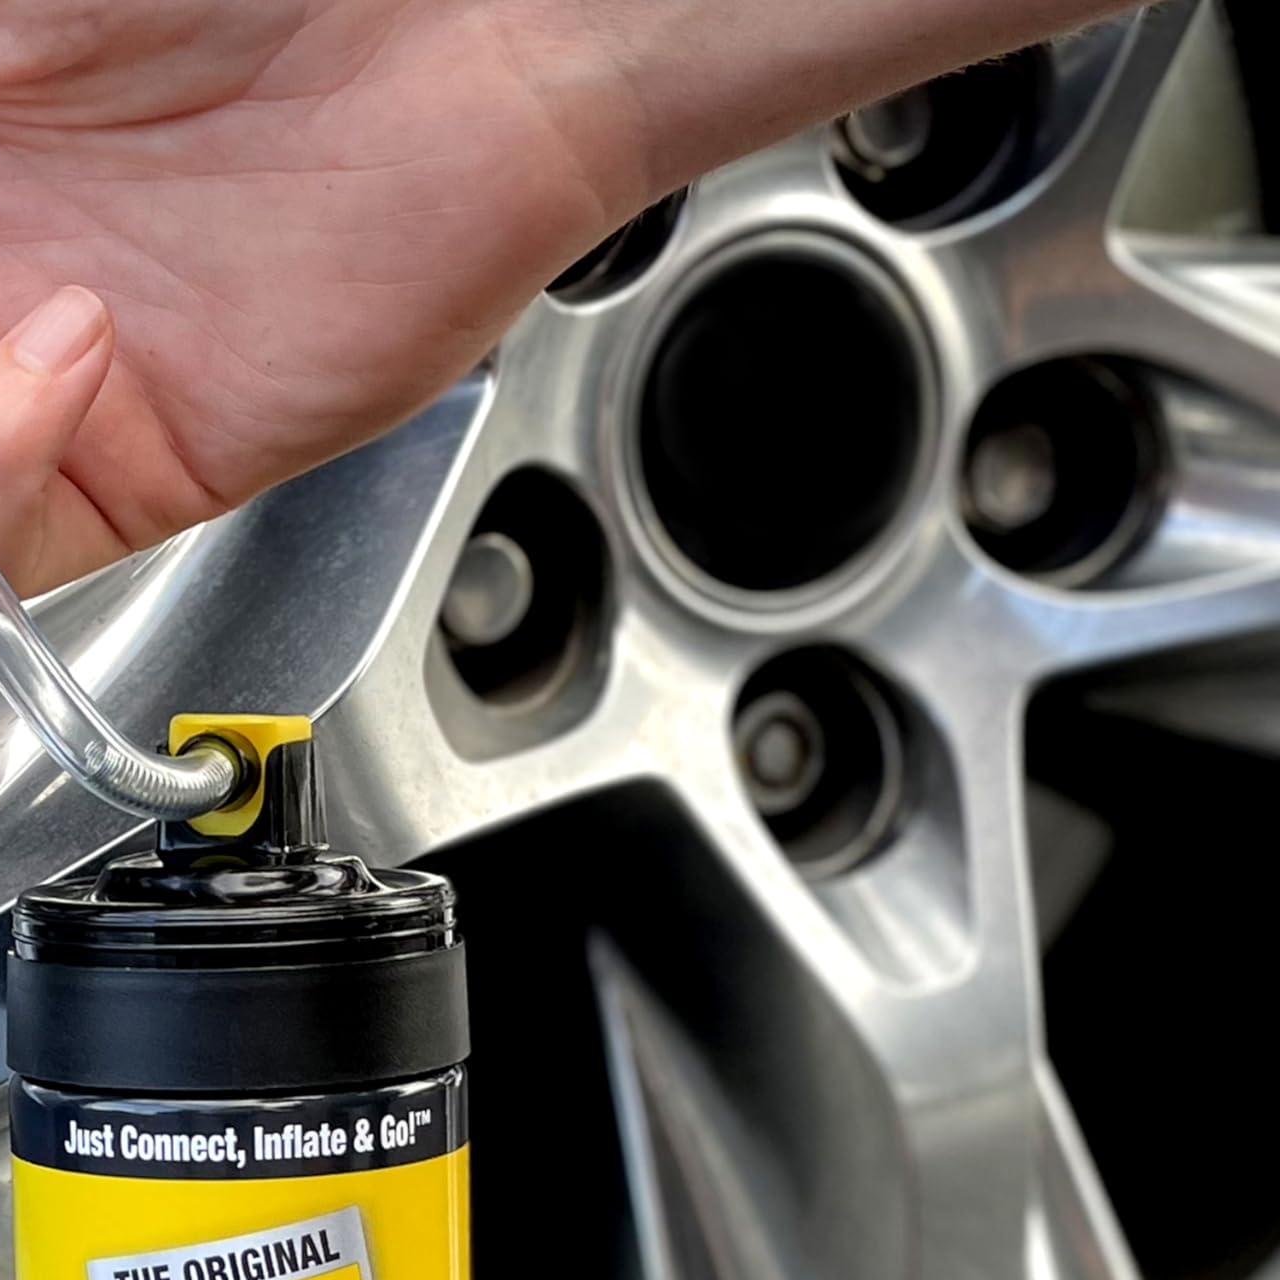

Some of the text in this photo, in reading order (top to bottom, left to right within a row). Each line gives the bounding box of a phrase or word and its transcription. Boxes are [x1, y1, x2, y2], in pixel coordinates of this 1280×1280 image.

[64, 1120, 114, 1157] Just
[120, 1124, 246, 1168] Connect,
[254, 1121, 347, 1162] Inflate
[354, 1118, 375, 1153] &
